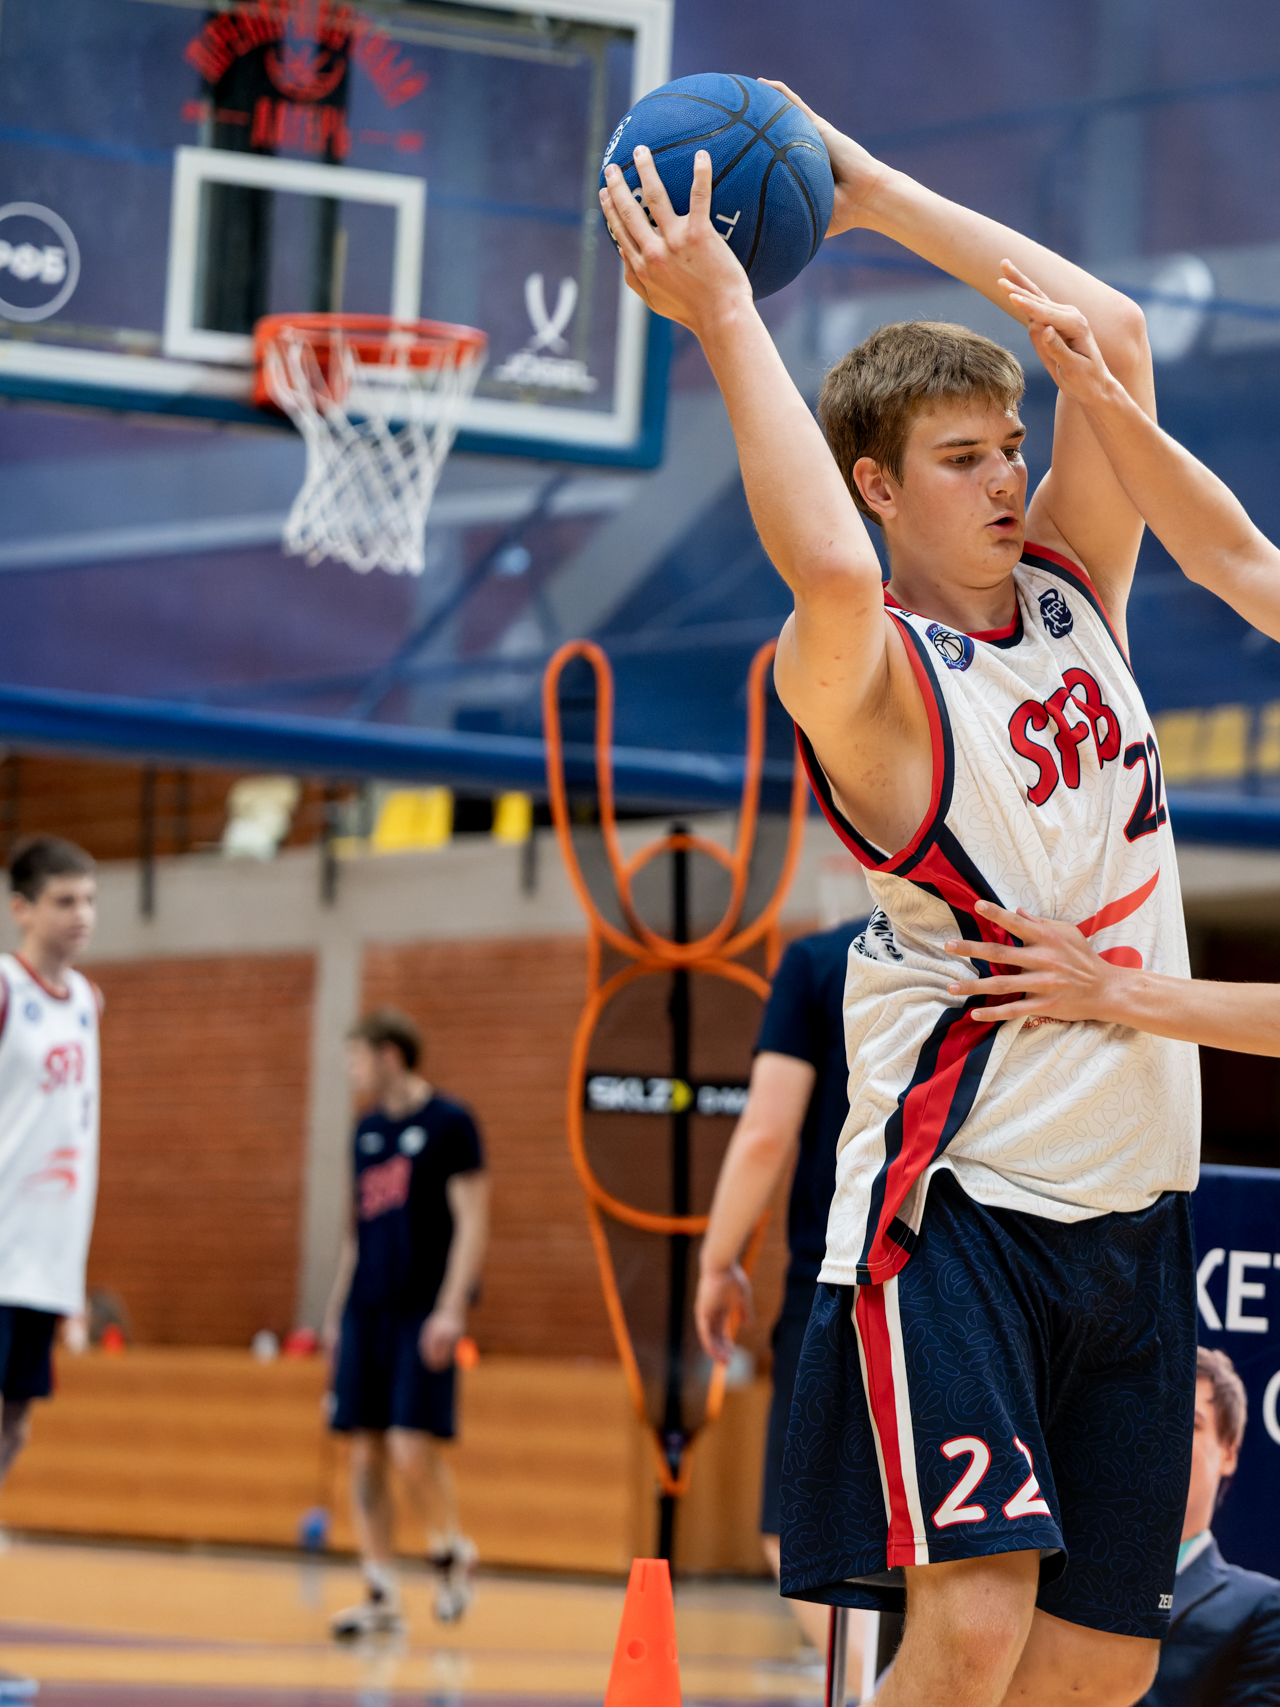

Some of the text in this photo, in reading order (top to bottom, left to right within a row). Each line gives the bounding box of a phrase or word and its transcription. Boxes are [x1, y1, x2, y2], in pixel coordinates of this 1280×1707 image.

[1008, 667, 1121, 807] SFB
[1123, 732, 1167, 843] 22
[931, 1435, 1051, 1529] 22
